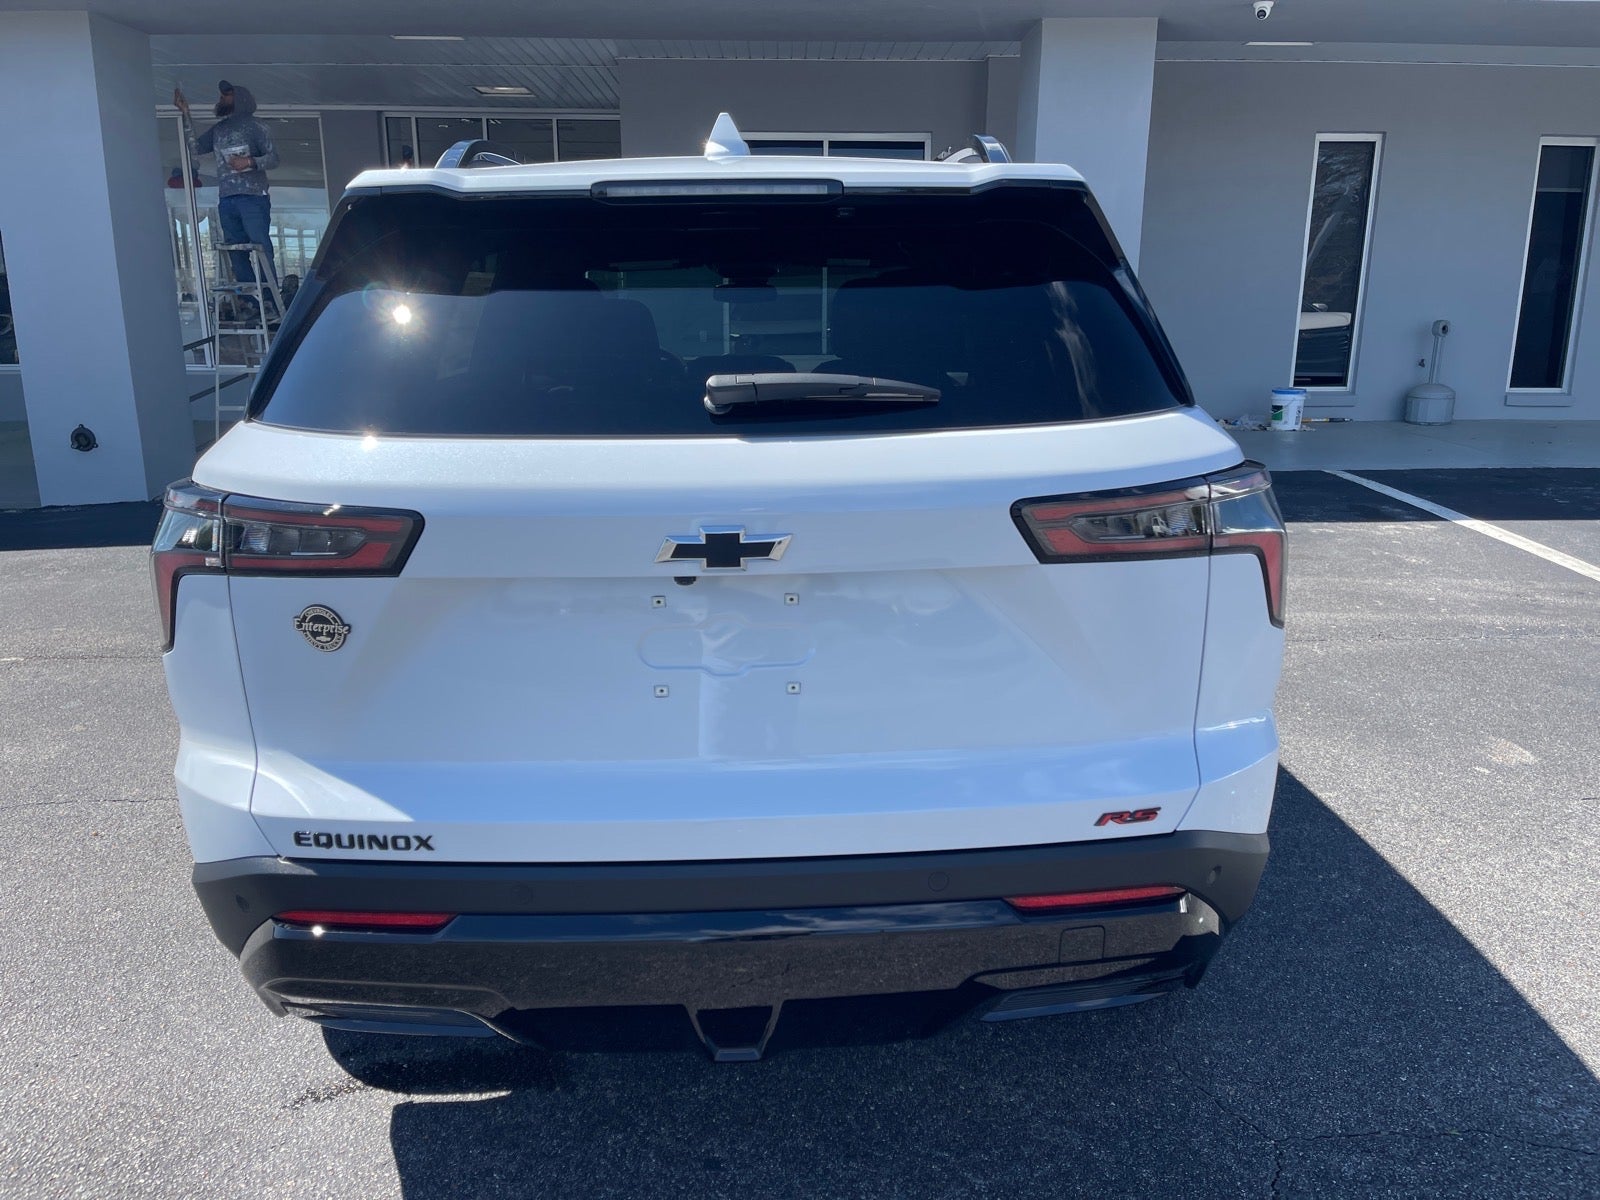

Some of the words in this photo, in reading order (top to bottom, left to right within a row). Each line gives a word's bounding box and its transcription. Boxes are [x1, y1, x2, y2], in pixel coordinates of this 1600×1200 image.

[294, 618, 350, 636] Enterprise
[1094, 807, 1161, 826] RS
[293, 831, 435, 851] EQUINOX
